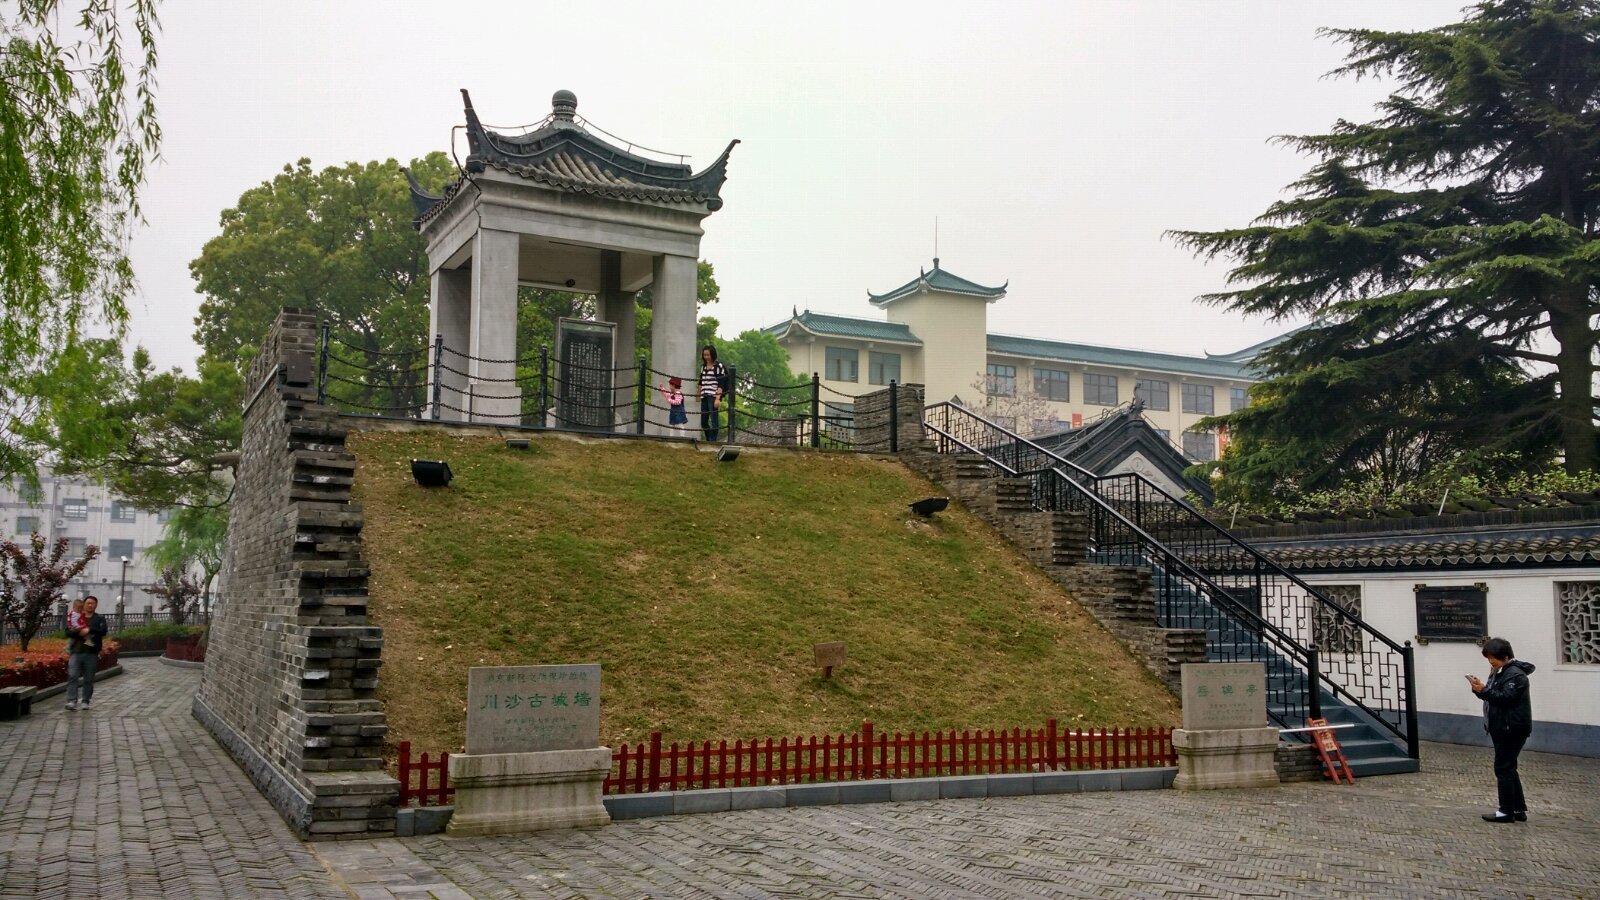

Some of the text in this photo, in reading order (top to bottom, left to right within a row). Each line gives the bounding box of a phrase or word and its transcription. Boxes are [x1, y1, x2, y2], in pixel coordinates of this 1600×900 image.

[480, 691, 592, 710] 川沙古城墙
